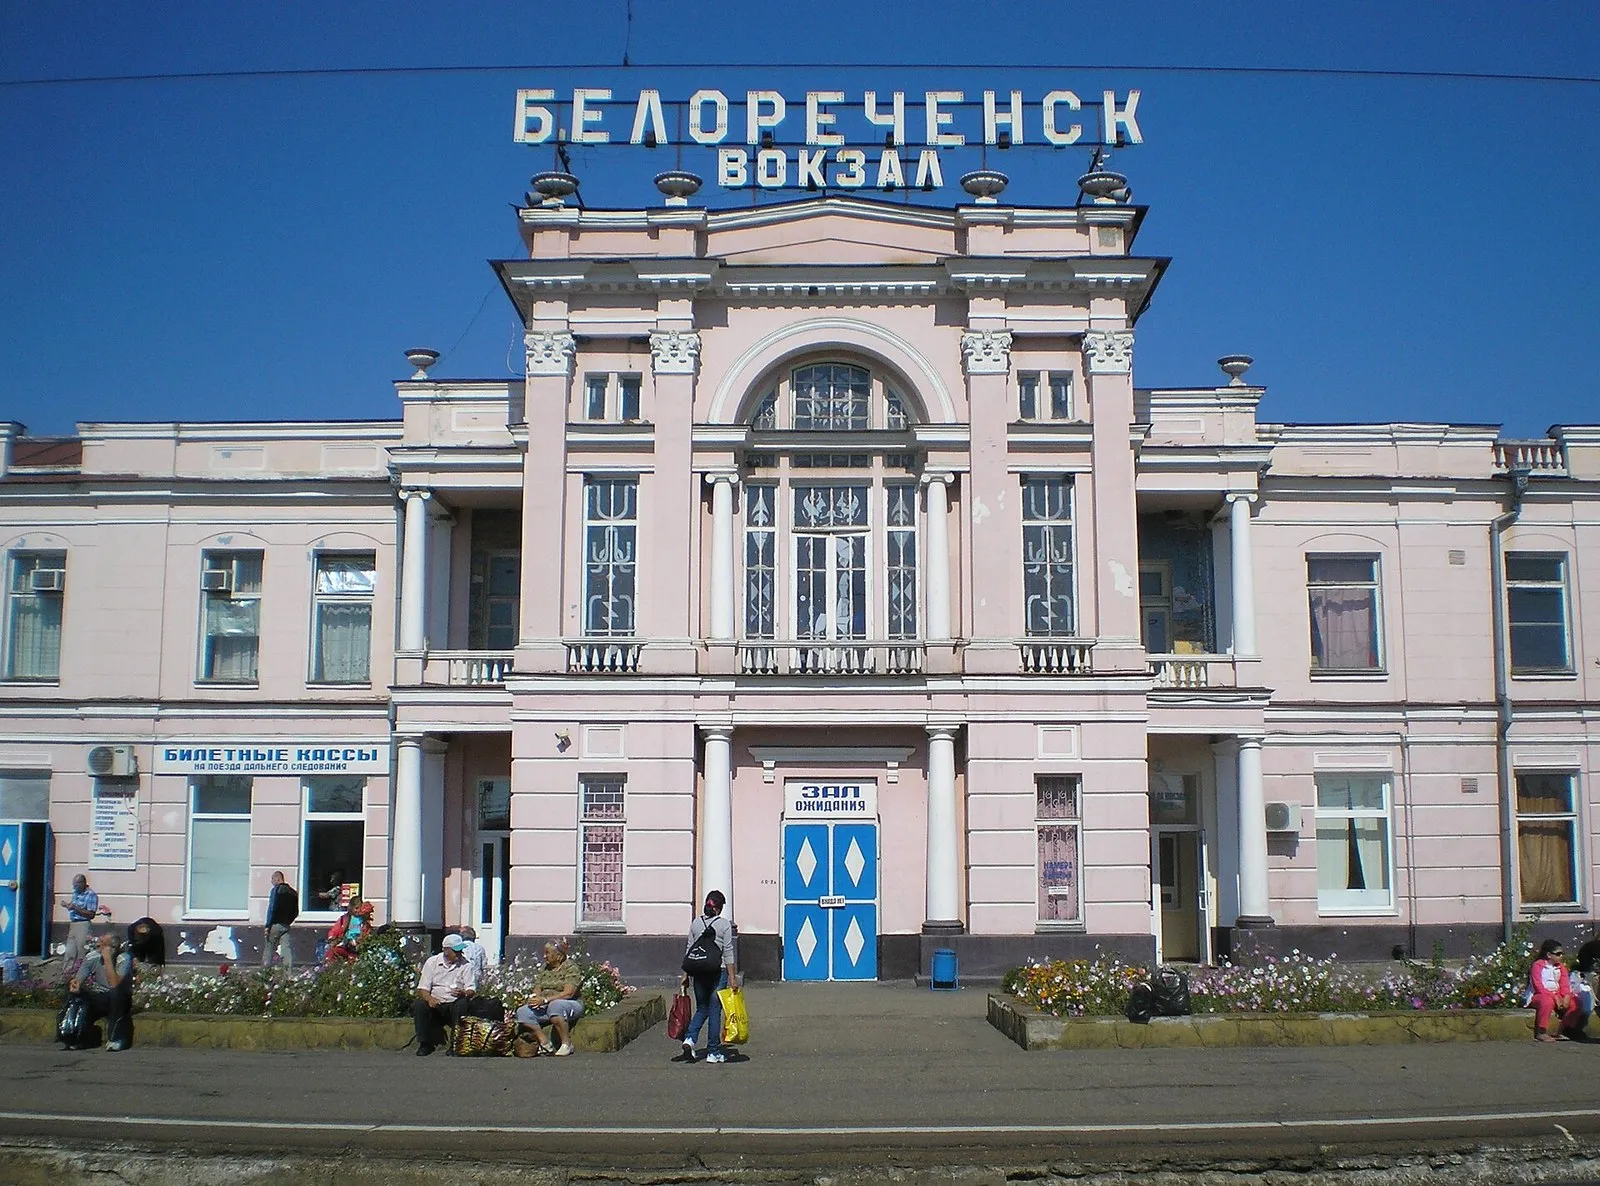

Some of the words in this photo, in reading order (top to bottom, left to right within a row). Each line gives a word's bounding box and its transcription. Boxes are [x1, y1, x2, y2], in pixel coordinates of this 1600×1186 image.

[513, 89, 1143, 145] БЕЛОРЕЧЕНСК
[717, 148, 943, 189] ВОКЗАЛ
[164, 748, 288, 762] БИЛЕТНЫЕ
[296, 748, 378, 762] КАССЫ
[194, 763, 205, 771] НА
[208, 763, 241, 771] ПОЕЗДА
[244, 763, 288, 771] ДАЛЬНЕГО
[291, 763, 347, 771] СЛЕДОВАНИЯ
[801, 785, 860, 799] ЗАЛ
[795, 800, 866, 812] ОЖИДАНИЯ
